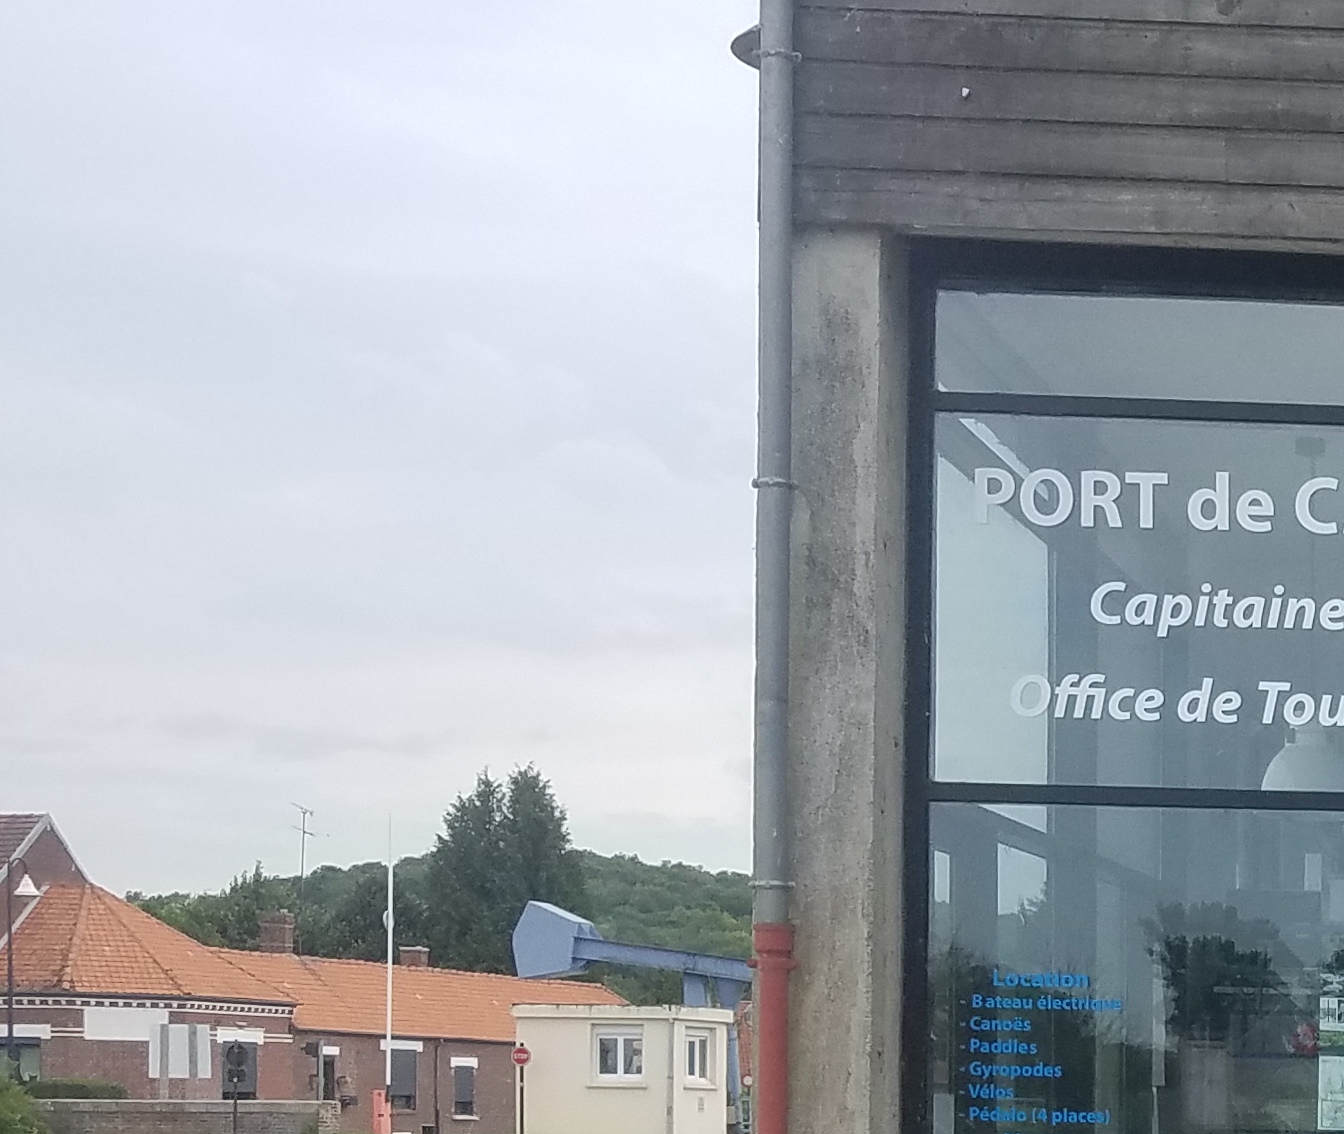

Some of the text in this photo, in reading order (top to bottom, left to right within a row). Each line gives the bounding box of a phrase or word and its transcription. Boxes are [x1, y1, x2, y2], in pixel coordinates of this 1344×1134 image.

[974, 467, 1168, 530] PORT
[1187, 471, 1275, 533] de
[1009, 672, 1162, 721] Office
[1177, 677, 1242, 724] de
[993, 969, 1090, 988] Location
[972, 993, 1123, 1011] Bateau électrique
[970, 1016, 1031, 1031] Canoës
[970, 1038, 1038, 1054] Paddles
[969, 1061, 1062, 1079] Gyropodes
[968, 1083, 1014, 1099] Vélos
[969, 1106, 1111, 1125] Pédalo (4 places)
